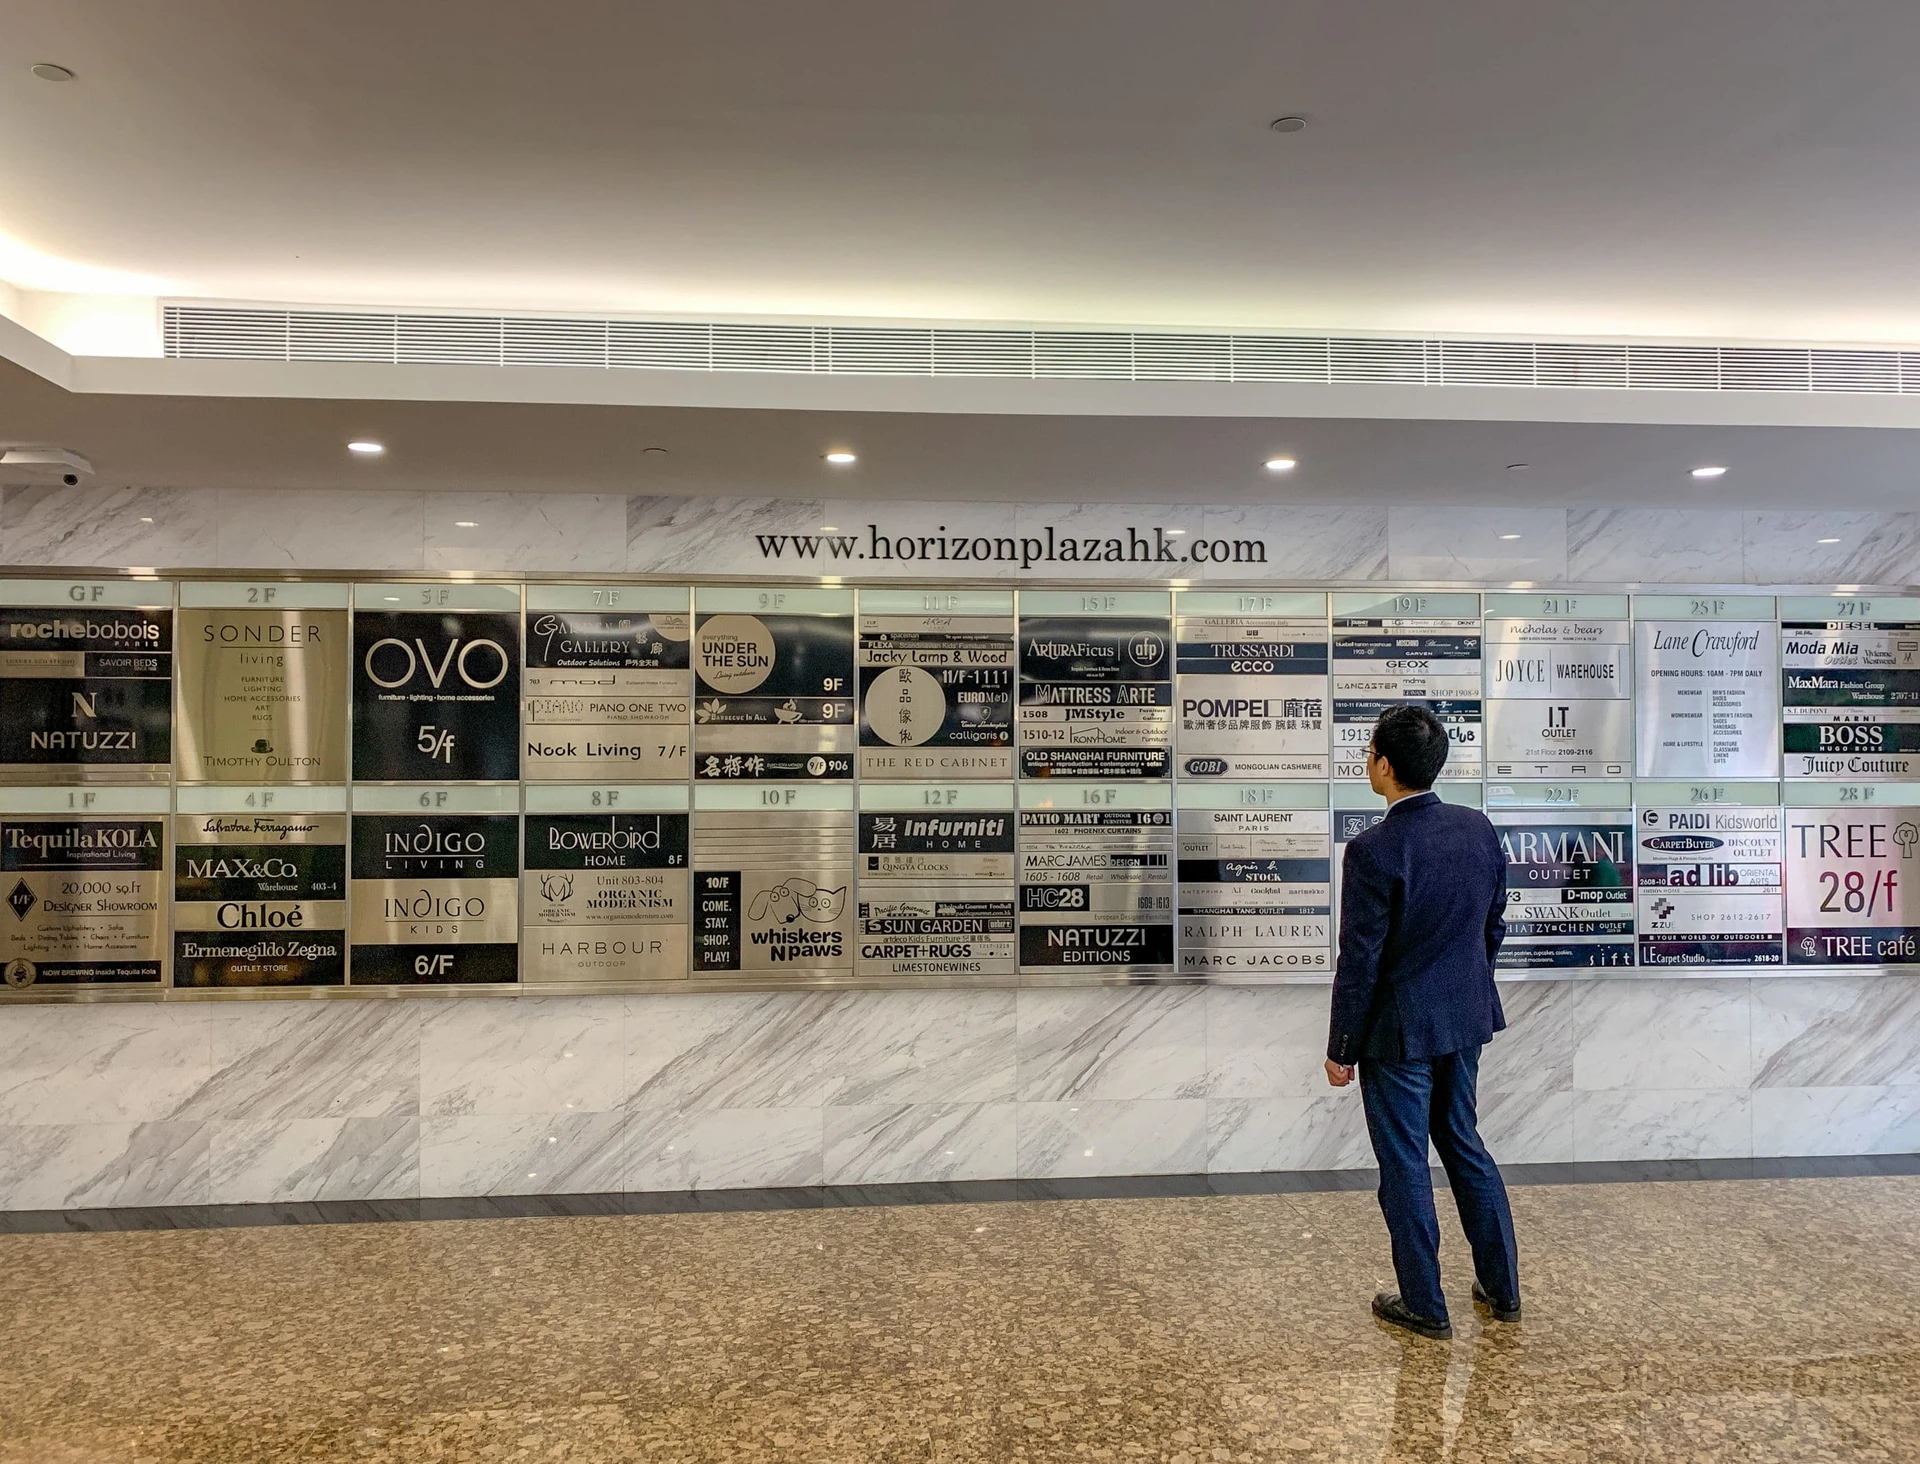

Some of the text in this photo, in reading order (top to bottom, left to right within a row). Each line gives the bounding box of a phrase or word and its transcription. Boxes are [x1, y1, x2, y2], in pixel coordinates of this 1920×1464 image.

[756, 524, 1267, 568] www.horizonplazahk.com
[10, 620, 160, 639] rochebobois
[1510, 625, 1604, 635] nicholas bears
[1826, 622, 1879, 630] DIESEL
[204, 625, 321, 642] SONDER
[702, 634, 738, 642] everything
[560, 641, 630, 653] GALLERY
[702, 642, 757, 654] UNDER
[1653, 628, 1760, 657] Lane Crawford
[1785, 641, 1859, 655] Moda Mia
[1210, 644, 1294, 657] TRUSSARDI
[99, 659, 158, 667] SAVOIR BEDS
[240, 653, 283, 667] living
[365, 638, 508, 689] OVO
[703, 655, 768, 667] THE SUN
[866, 651, 1007, 665] Jacky Lamp Wood
[1386, 660, 1429, 668] GEOX
[1231, 660, 1274, 673] ecco
[1496, 659, 1545, 682] JOYCE
[1556, 664, 1615, 679] WAREHOUSE
[823, 678, 843, 691] 9F
[1787, 676, 1838, 689] MaxMara
[1035, 684, 1156, 704] MATTRESS ARTE
[1431, 689, 1453, 697] SHOP
[1455, 689, 1480, 697] 1908-9
[1851, 692, 1918, 700] Warehouse 2707-11
[589, 703, 687, 712] PIANO ONE TWO
[822, 703, 845, 719] 9F
[1183, 699, 1269, 718] POMPEI
[1023, 710, 1048, 718] 1508
[1065, 708, 1125, 722] JMStyle
[949, 730, 998, 741] calligaris
[1023, 730, 1065, 740] 1510-12
[1541, 729, 1577, 738] OUTLET
[1819, 725, 1883, 745] BOSS
[30, 731, 136, 749] NATUZZI
[417, 725, 455, 763] 5/f
[527, 741, 641, 761] Nook Living
[1026, 752, 1166, 761] OLD SHANGHAI FURNITURE
[1558, 748, 1593, 756] 2109-2116
[203, 756, 321, 766] TIMOTHY OULTON
[828, 760, 848, 771] 906
[866, 757, 1008, 767] THE RED CABINET
[1803, 756, 1910, 776] Juicy Couture
[1021, 813, 1100, 824] PATIO MART
[1214, 813, 1293, 822] SAINT LAURENT
[1669, 814, 1778, 829] PAIDI Kidsworld
[871, 816, 898, 849] 易居
[903, 819, 1005, 836] Infurniti
[926, 840, 981, 849] HOME
[1728, 839, 1778, 847] DISCOUNT
[1791, 824, 1887, 858] TREE
[1733, 849, 1773, 857] OUTLET
[385, 859, 485, 869] LIVING
[584, 855, 627, 866] HOME
[1111, 858, 1140, 866] DESIGN
[186, 858, 298, 878] MAX&Co.
[1740, 869, 1778, 877] ORIENTAL
[596, 875, 664, 886] Unit 803-804
[1245, 873, 1282, 881] STOCK
[1529, 869, 1591, 880] OUTLET
[62, 881, 112, 895] 20,000
[257, 882, 298, 891] Warehouse
[705, 877, 729, 888] 10/F
[598, 889, 663, 898] ORGANIC
[1027, 888, 1085, 908] HC28
[1567, 890, 1603, 902] D-mop
[1819, 869, 1898, 917] 28/f
[43, 899, 158, 913] DESIGNER SHOWROOM
[586, 899, 673, 909] MODERNISM
[702, 901, 732, 912] COME.
[217, 902, 303, 928] Chloé
[1524, 906, 1611, 919] SWANK Outlet
[410, 925, 459, 934] KIDS
[705, 918, 729, 929] STAY.
[884, 919, 983, 932] SUN GARDEN
[751, 928, 843, 945] whiskers
[1184, 925, 1325, 937] RALPH LAUREN
[703, 935, 731, 946] SHOP.
[1048, 929, 1146, 947] NATUZZI
[182, 942, 337, 961] Ermenegildo Zegna
[543, 941, 662, 955] HARBOUR
[861, 944, 972, 958] CARPET+RUGS
[1822, 936, 1916, 955] TREE café
[704, 952, 730, 963] PLAY!
[1063, 951, 1131, 963] EDITIONS
[1184, 955, 1325, 965] MARC JACOBS
[1754, 954, 1779, 962] 2618-20
[231, 964, 288, 972] OUTLET STORE
[414, 955, 454, 975] 6/F
[892, 962, 981, 973] LIMESTONEWINES
